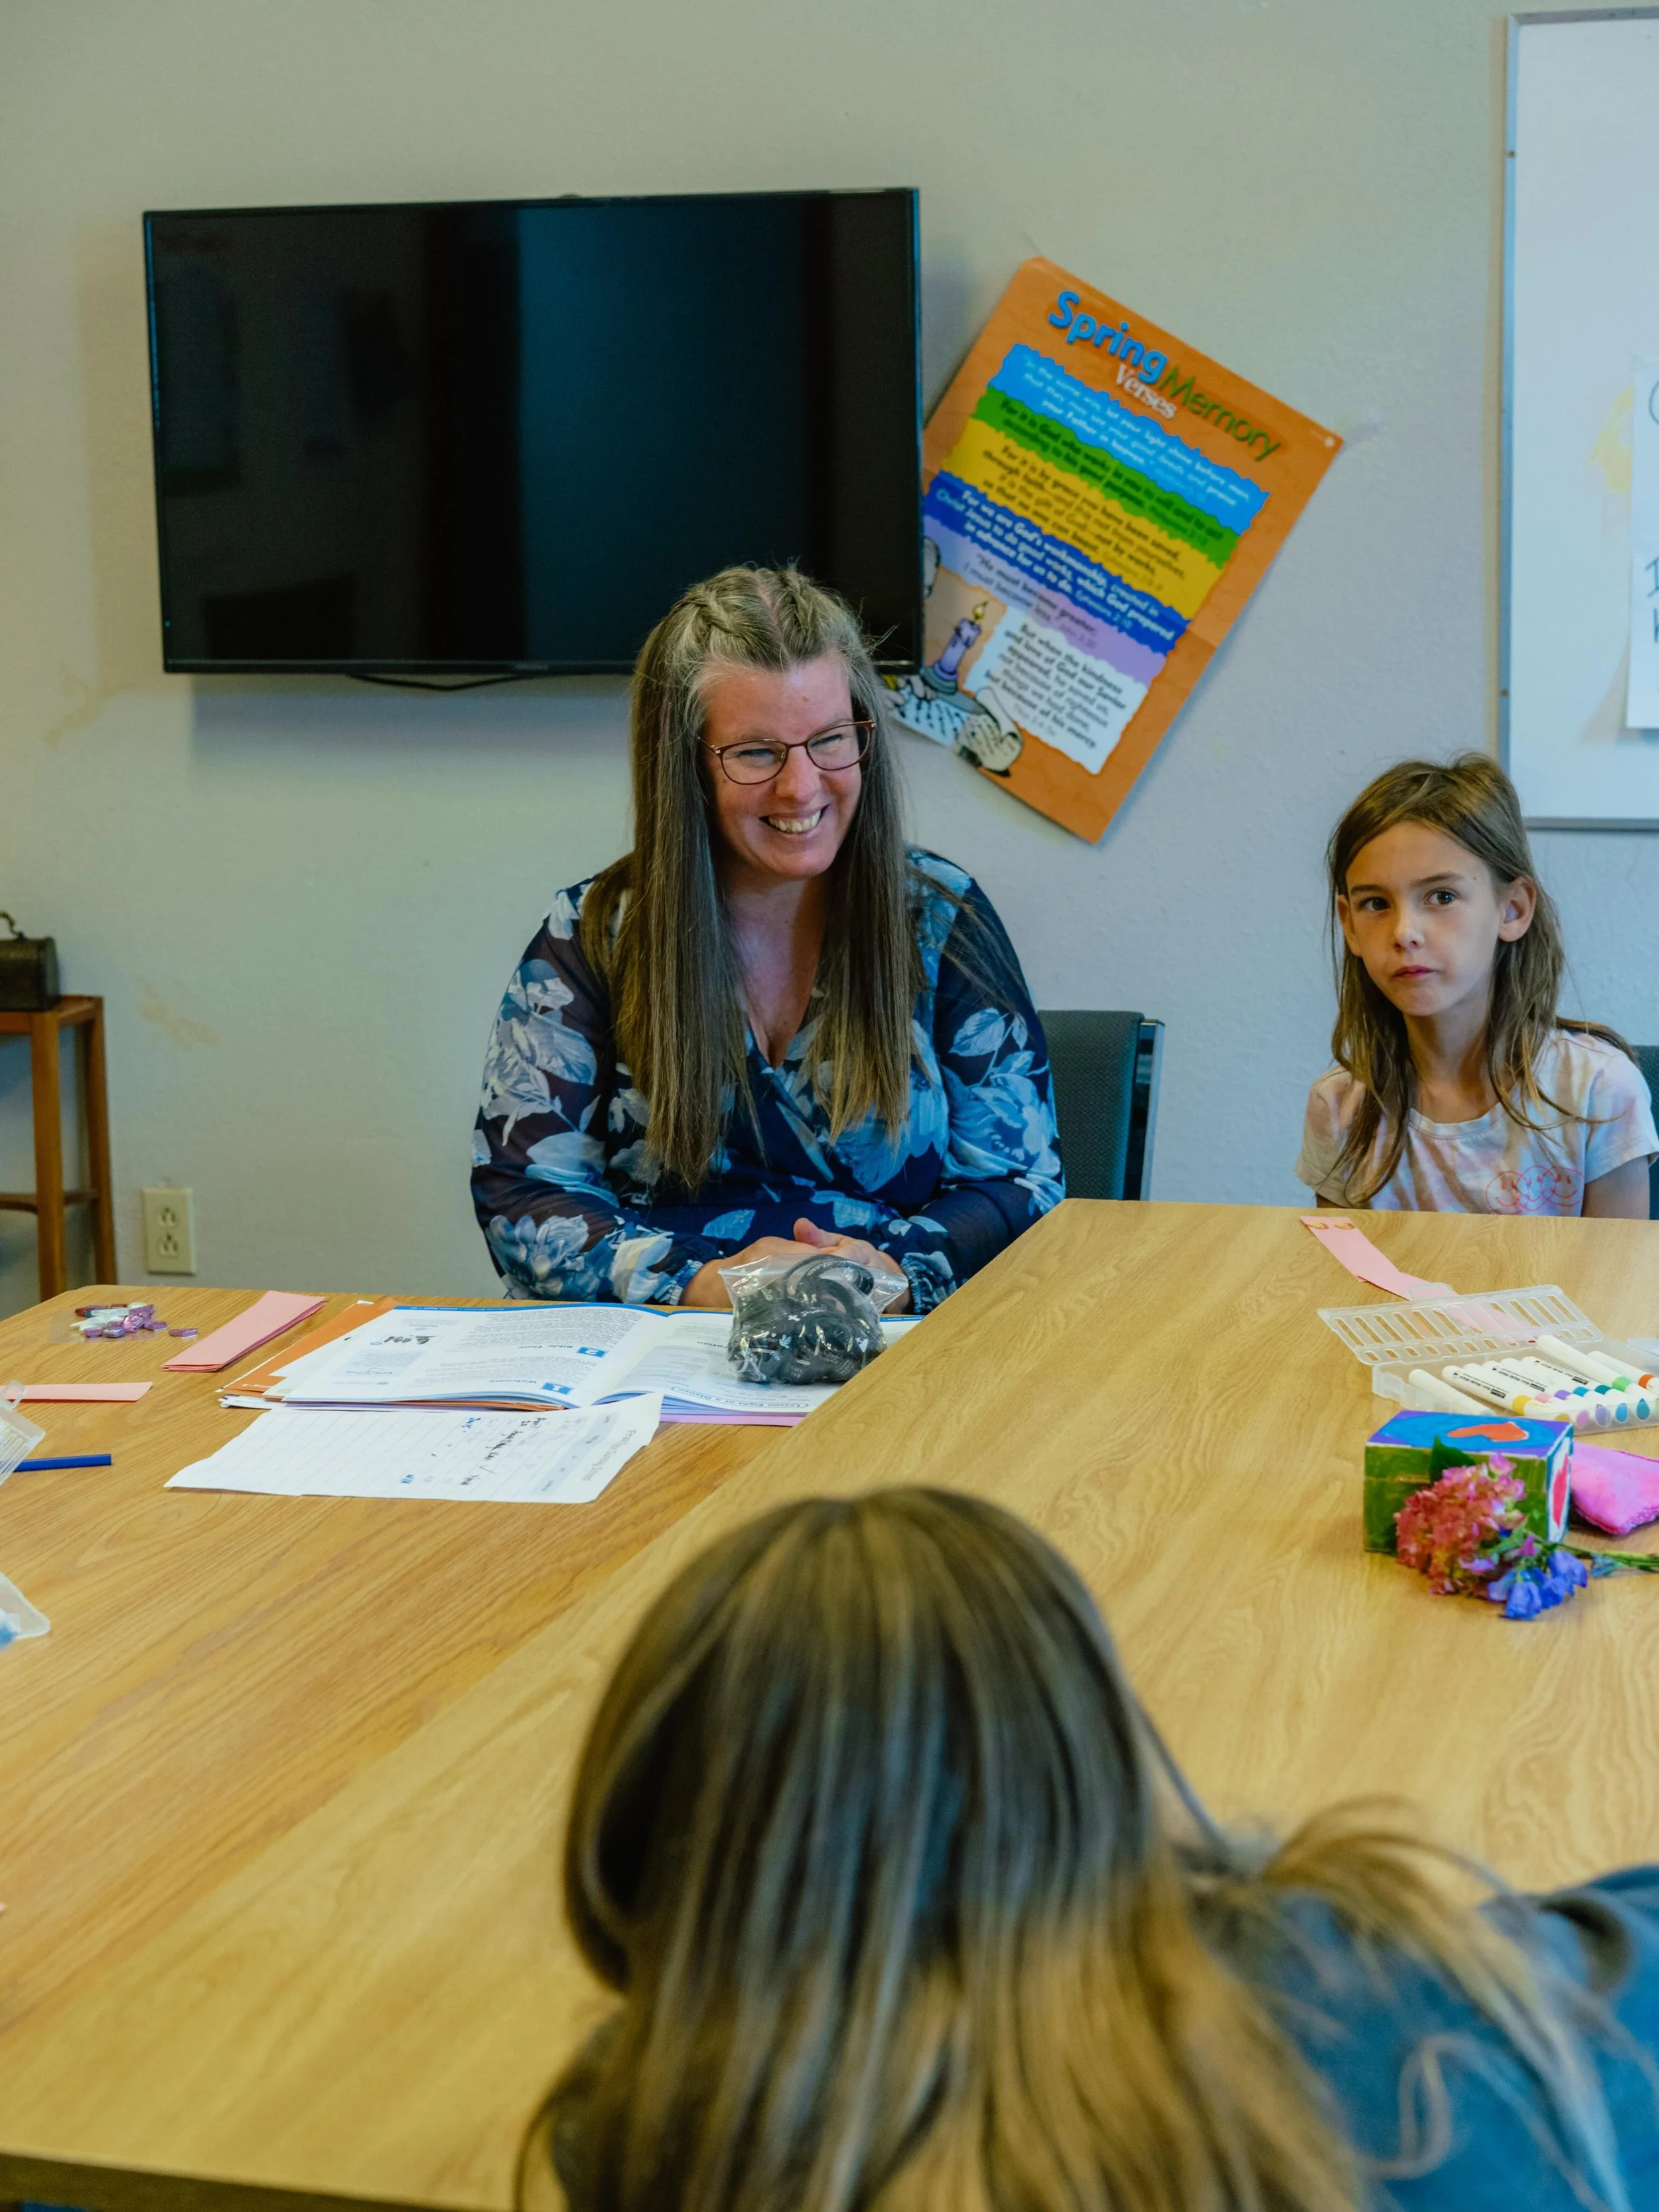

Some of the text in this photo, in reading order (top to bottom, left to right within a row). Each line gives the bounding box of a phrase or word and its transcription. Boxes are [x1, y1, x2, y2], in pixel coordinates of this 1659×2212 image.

[1049, 290, 1281, 462] Spring Memory
[1114, 362, 1178, 420] Verses
